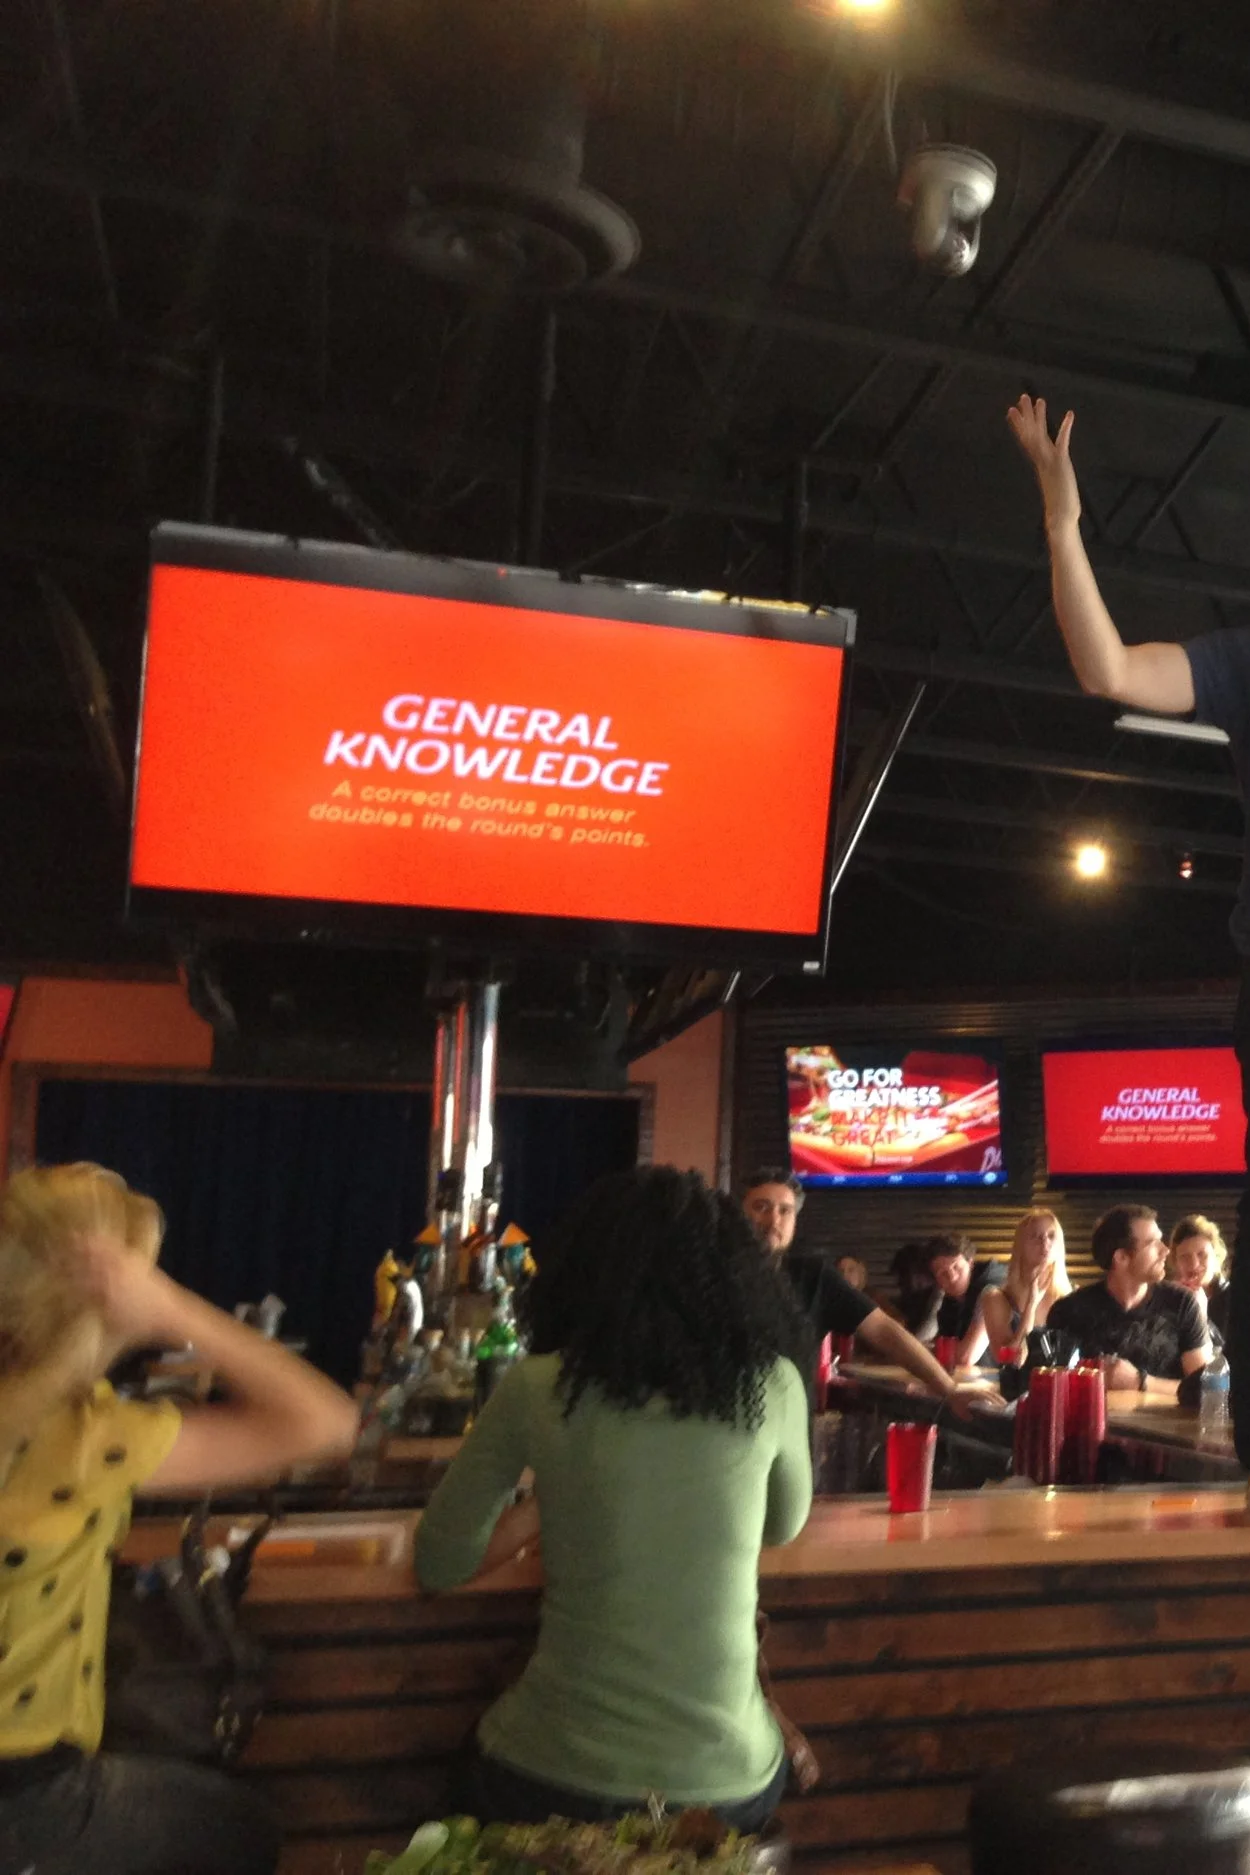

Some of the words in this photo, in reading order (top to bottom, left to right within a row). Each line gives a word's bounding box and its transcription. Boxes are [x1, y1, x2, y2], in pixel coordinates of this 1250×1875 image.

[382, 694, 619, 750] GENERAL
[323, 730, 670, 796] KNOWLEDGE
[331, 780, 352, 799] A
[360, 785, 452, 809] correct
[458, 793, 537, 816] bonus
[544, 802, 637, 824] answer
[308, 803, 412, 828] doubles
[421, 813, 463, 833] the
[470, 818, 564, 842] round's
[827, 1068, 859, 1089] GO
[863, 1067, 903, 1087] FOR
[828, 1086, 941, 1108] GREATNESS
[1118, 1087, 1201, 1104] GENERAL
[1101, 1104, 1220, 1121] KNOWLEDGE
